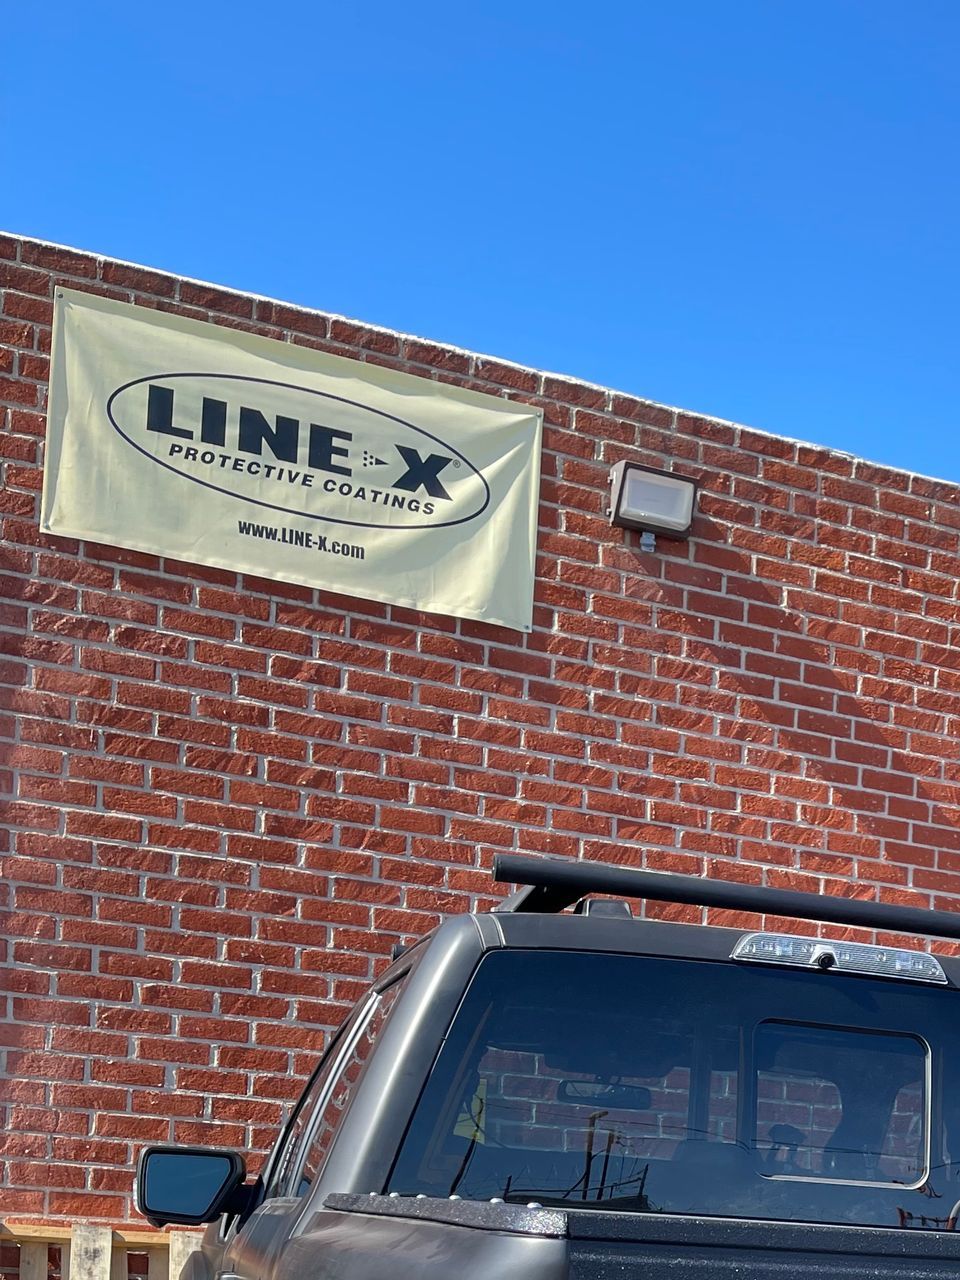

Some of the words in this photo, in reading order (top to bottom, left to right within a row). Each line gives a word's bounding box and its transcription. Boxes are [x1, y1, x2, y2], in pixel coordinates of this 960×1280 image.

[168, 443, 315, 488] PROTECTIVE
[323, 479, 436, 515] COATINGS
[238, 520, 365, 560] www.LINE-X.com
